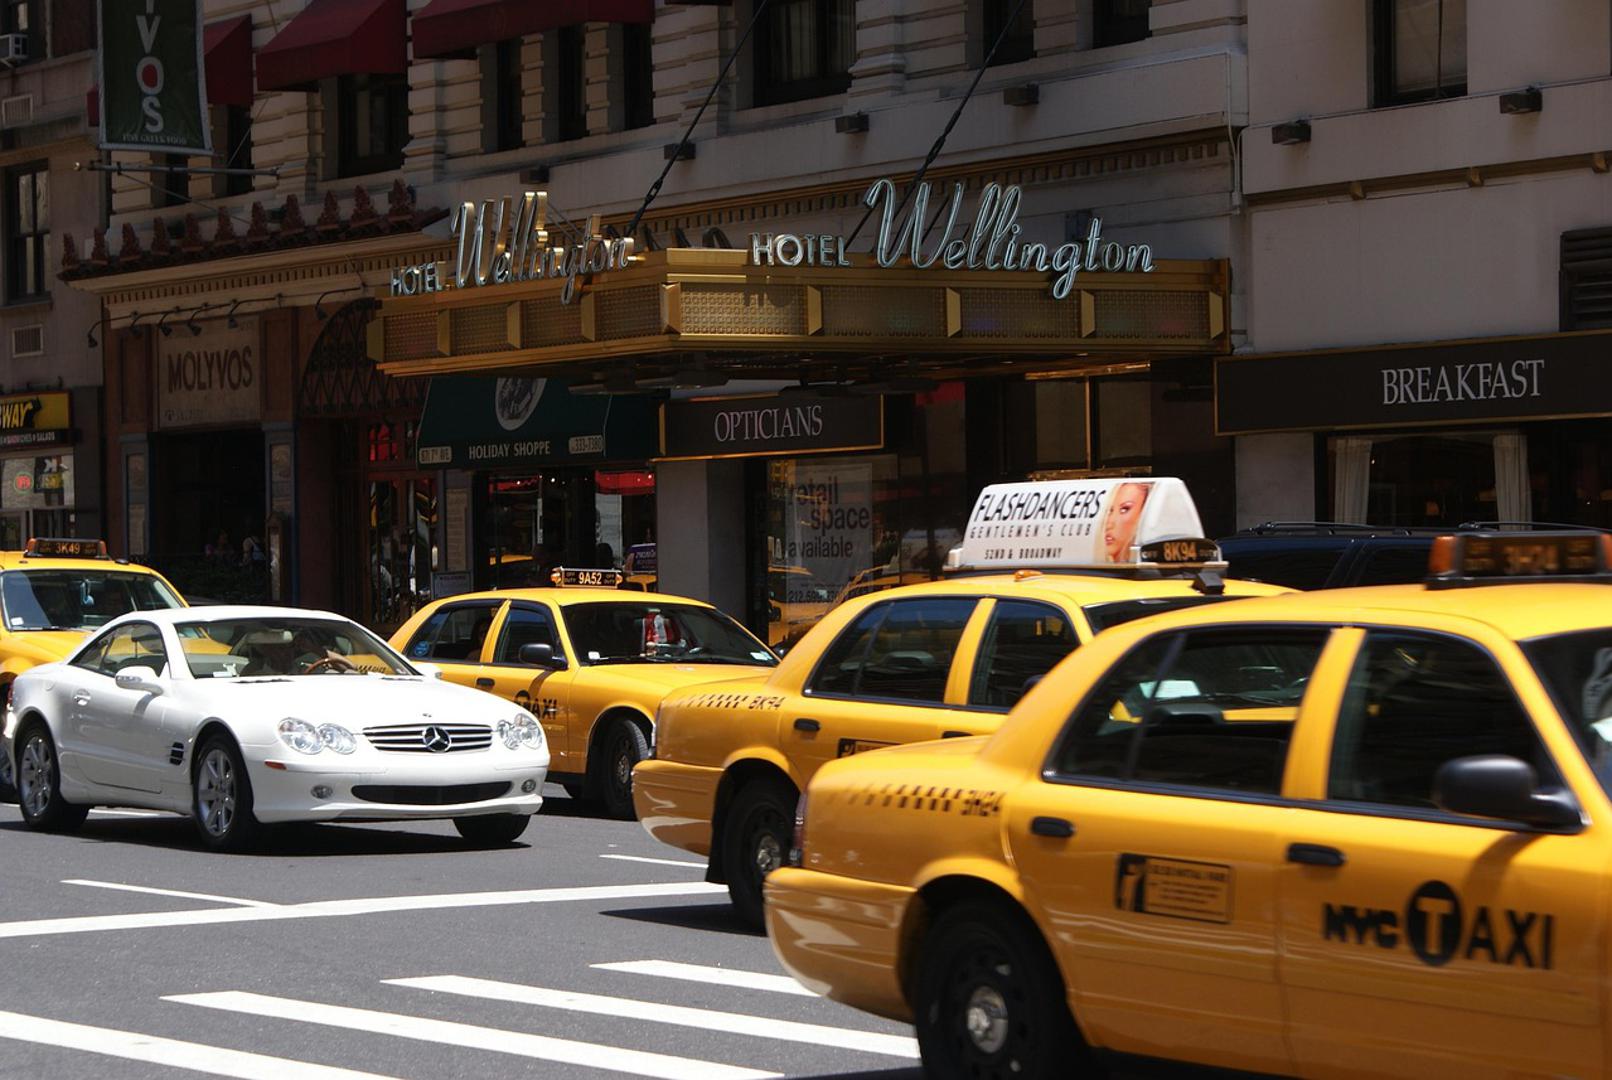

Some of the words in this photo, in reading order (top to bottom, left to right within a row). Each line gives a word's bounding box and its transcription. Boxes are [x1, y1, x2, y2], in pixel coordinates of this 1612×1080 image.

[390, 261, 446, 295] HOTEL
[450, 191, 637, 305] Wellington
[750, 232, 850, 267] HOTEL
[864, 178, 1156, 299] Wellington
[167, 345, 253, 393] MOLYVOS
[1381, 359, 1545, 405] BREAKFAST
[0, 402, 33, 428] WAY
[714, 404, 824, 443] OPTICIANS
[468, 444, 510, 460] HOLIDAY
[513, 440, 551, 457] SHOPPE
[973, 489, 1106, 523] FLASHDANCERS
[811, 507, 870, 537] space
[1060, 523, 1092, 536] CLUB
[56, 542, 81, 554] 3K49
[788, 536, 853, 559] available
[984, 549, 1006, 560] 52ND
[1018, 547, 1064, 560] BROADWAY
[1163, 541, 1199, 562] 8K94
[578, 571, 602, 586] 9A52
[1322, 903, 1399, 949] NYC
